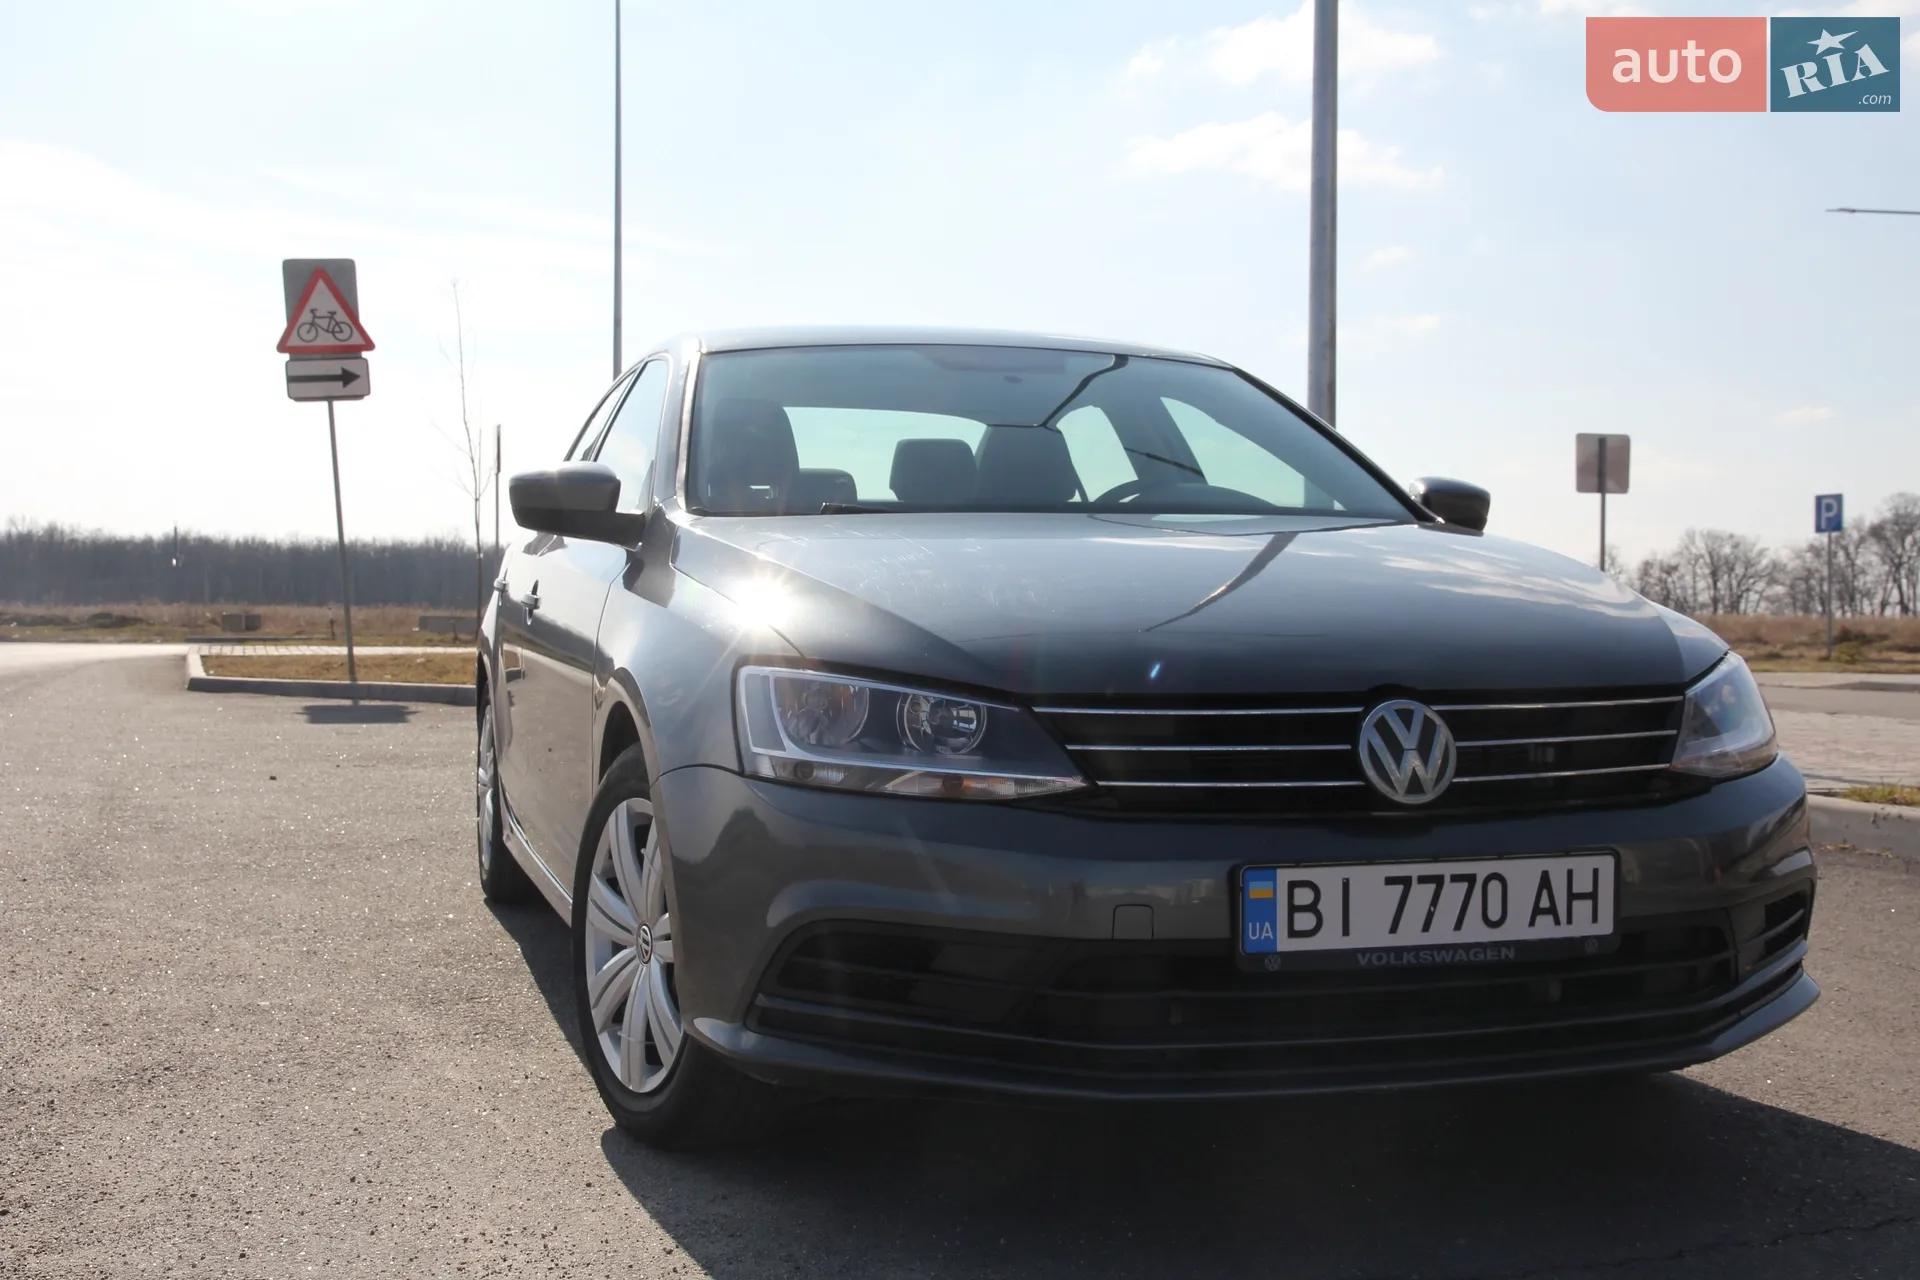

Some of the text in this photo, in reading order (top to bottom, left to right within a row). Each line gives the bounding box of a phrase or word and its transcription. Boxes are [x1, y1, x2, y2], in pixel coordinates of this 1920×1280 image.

[1821, 498, 1838, 529] P
[1287, 867, 1600, 939] BI 7770 AH
[1248, 921, 1274, 941] UA
[1356, 946, 1516, 966] VOLKSWAGEN
